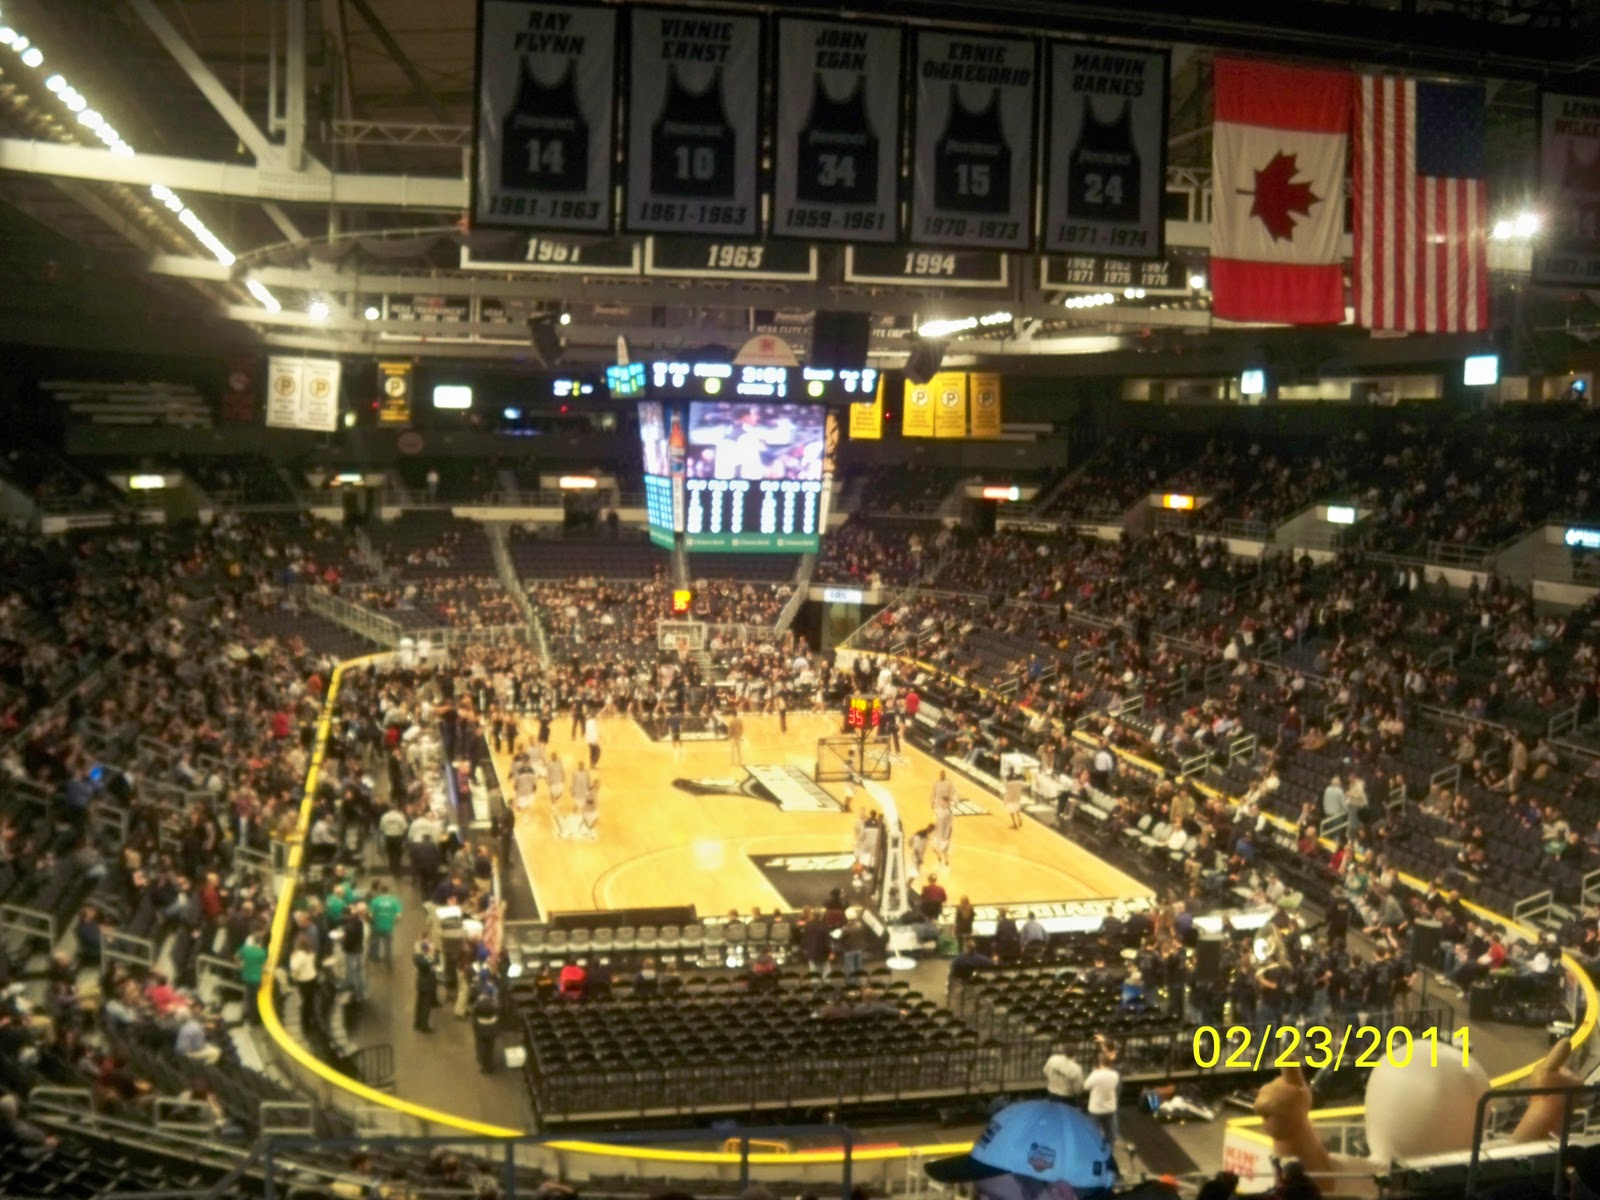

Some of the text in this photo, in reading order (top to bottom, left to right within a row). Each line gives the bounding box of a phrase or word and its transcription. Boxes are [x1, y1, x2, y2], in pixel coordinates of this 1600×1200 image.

[528, 11, 573, 32] RAY
[661, 18, 734, 41] VINNIE
[514, 33, 585, 55] FLYNN
[660, 41, 731, 62] ERNST
[815, 29, 868, 50] JOHN
[815, 50, 867, 70] EGAN
[948, 42, 1008, 64] ERNIE
[1072, 53, 1146, 77] MARVIN
[1072, 73, 1145, 97] BARNES
[526, 138, 565, 174] 14
[674, 145, 716, 180] 10
[816, 153, 857, 188] 34
[955, 162, 991, 197] 15
[1083, 173, 1124, 206] 24
[707, 243, 764, 269] 1963
[905, 251, 956, 276] 1994
[848, 708, 863, 725] 35
